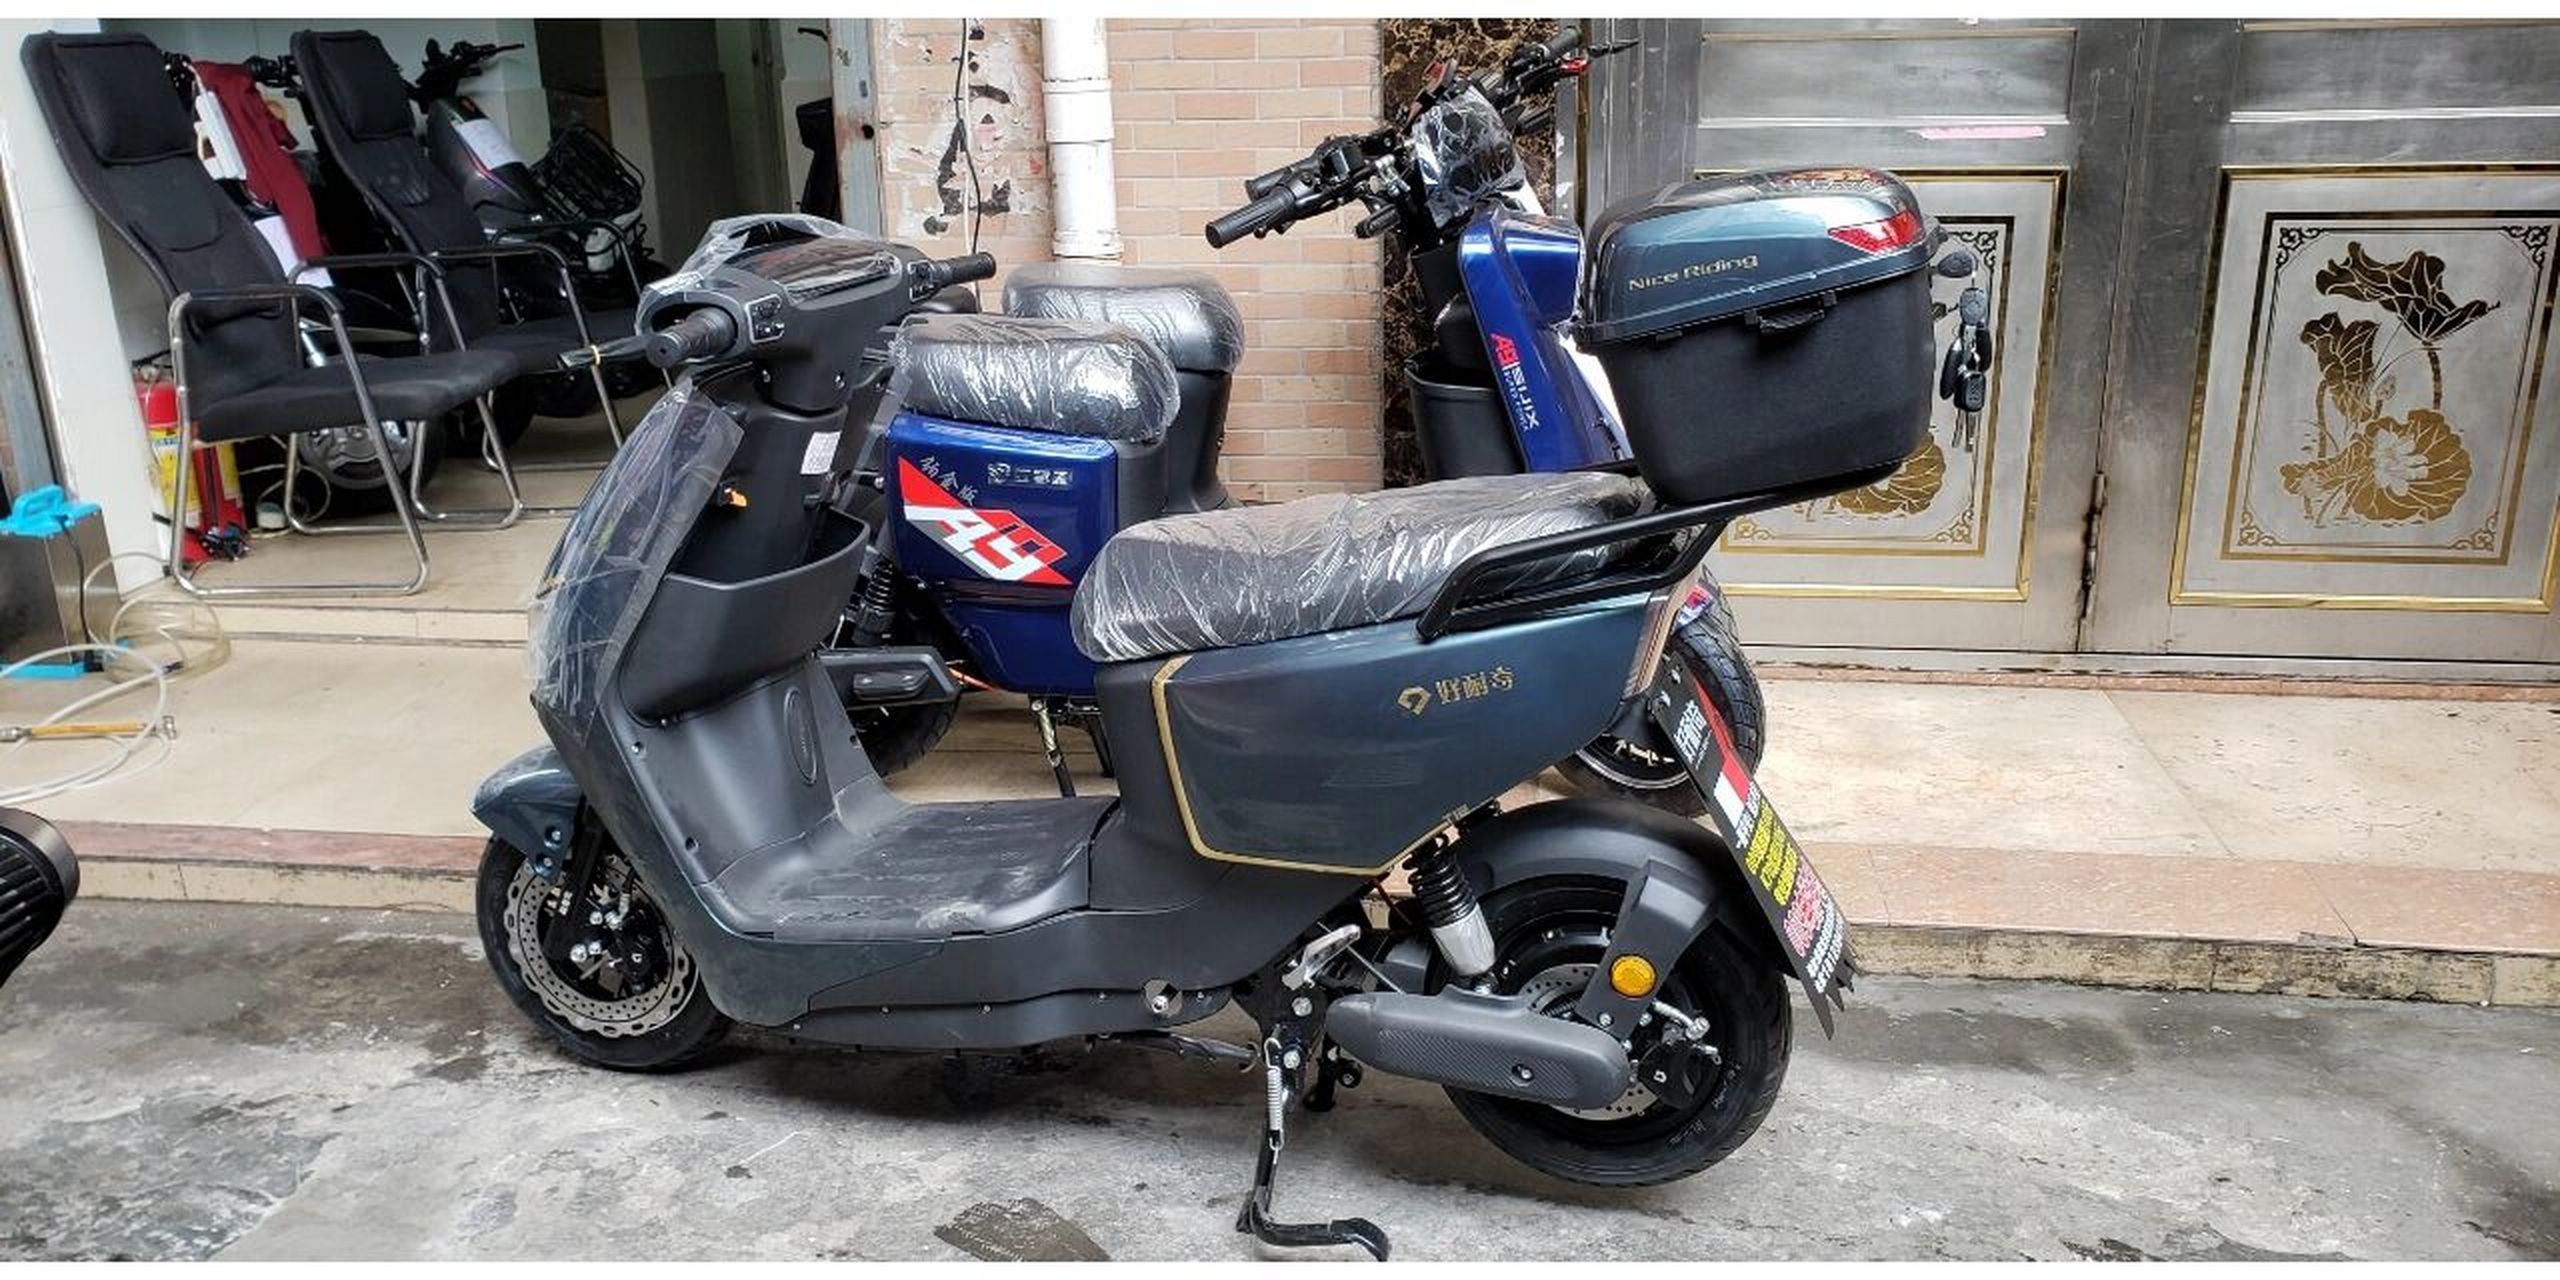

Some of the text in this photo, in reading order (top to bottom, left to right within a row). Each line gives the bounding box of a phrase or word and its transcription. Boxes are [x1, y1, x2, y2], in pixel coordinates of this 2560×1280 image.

[1628, 255, 1759, 291] Nice Riding
[919, 455, 979, 507] 铂金版
[904, 505, 1067, 581] A9
